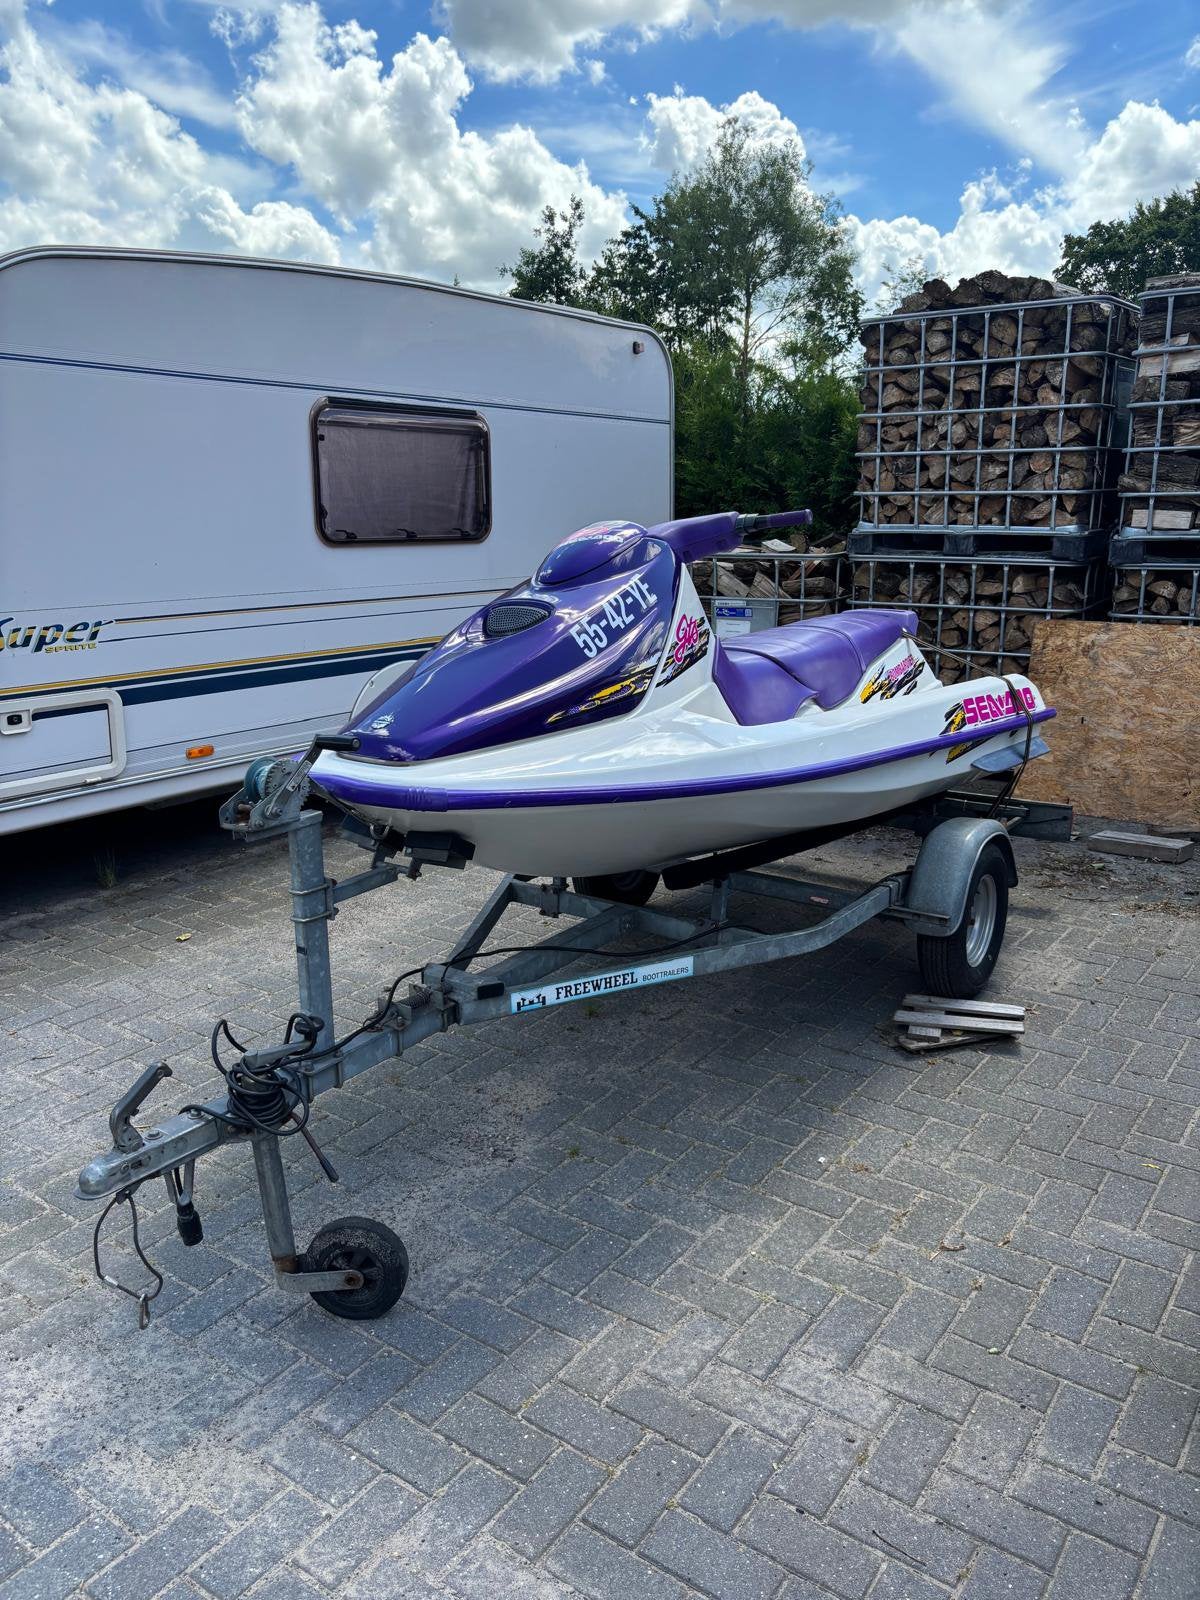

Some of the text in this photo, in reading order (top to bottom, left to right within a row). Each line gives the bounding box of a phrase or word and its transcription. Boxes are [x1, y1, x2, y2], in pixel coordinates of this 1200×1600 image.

[569, 573, 658, 658] 55-42-YE
[45, 642, 97, 654] SPRITE
[555, 966, 689, 1000] FREEWHEEL BOOTTRAILERS
